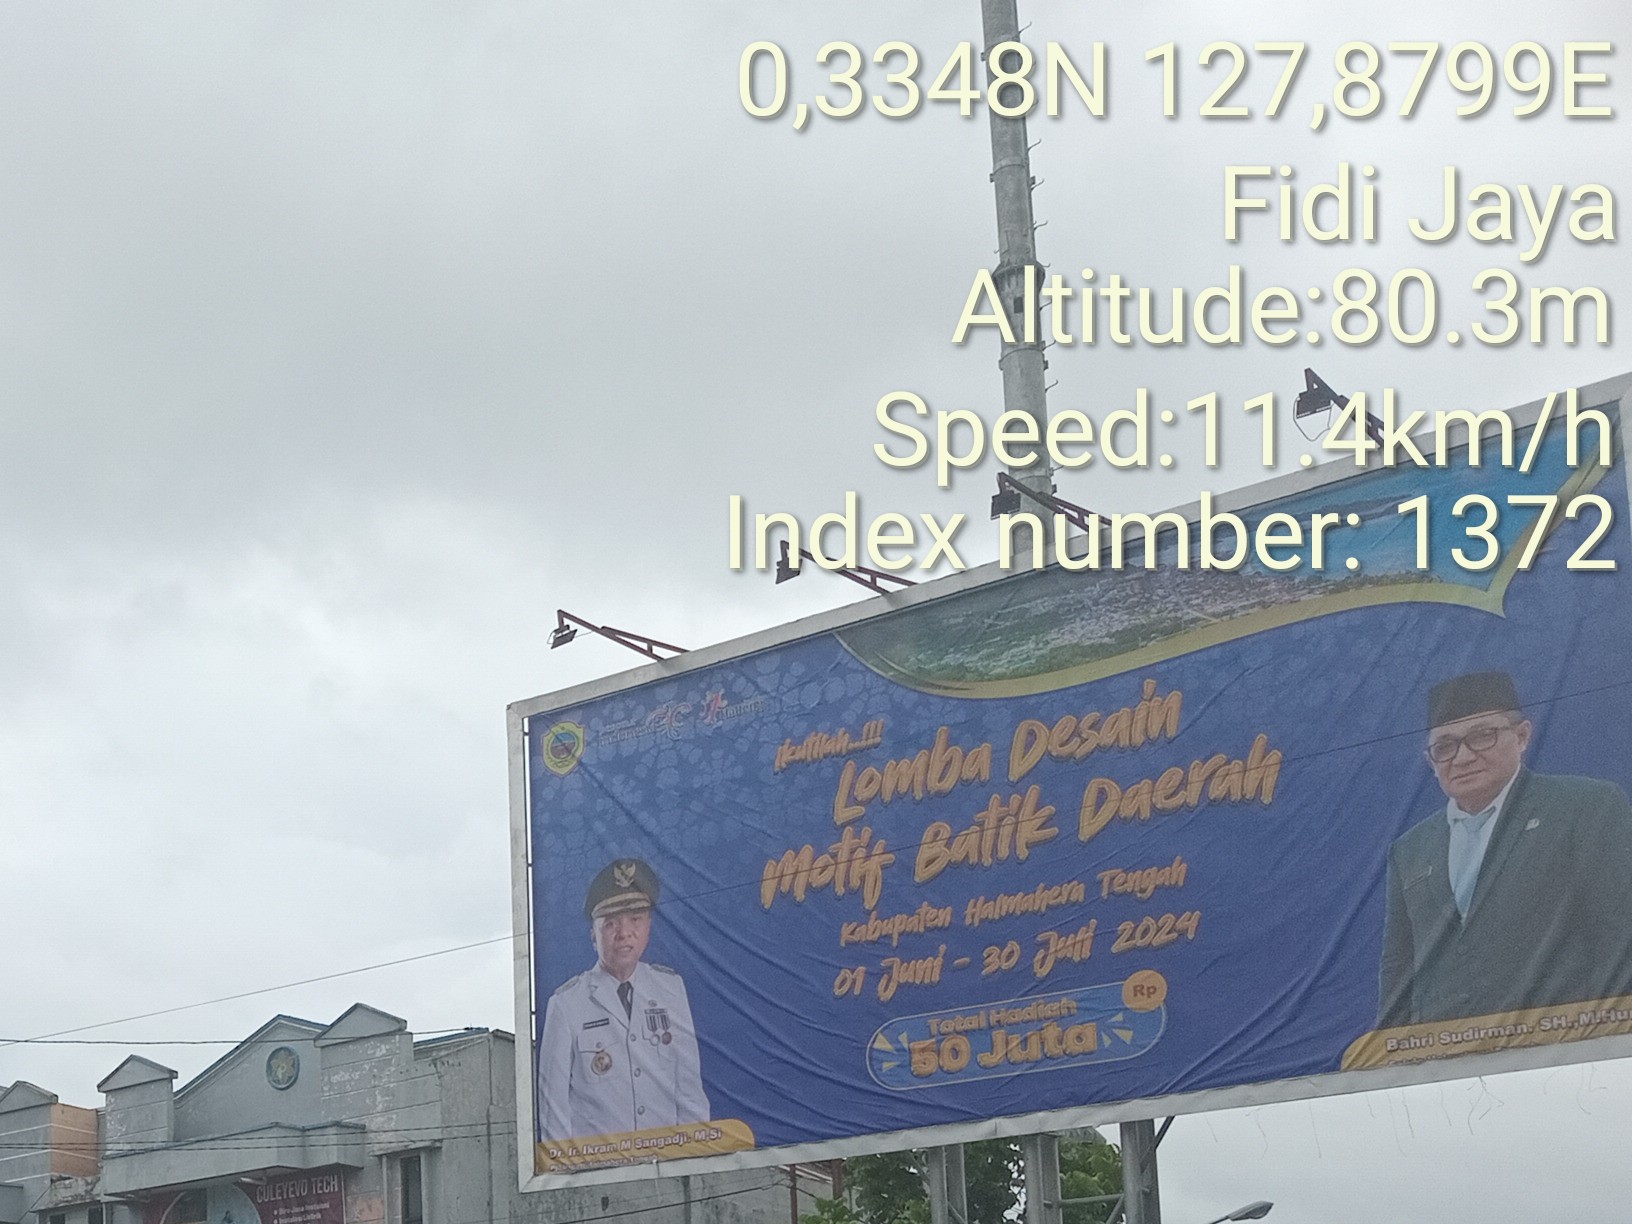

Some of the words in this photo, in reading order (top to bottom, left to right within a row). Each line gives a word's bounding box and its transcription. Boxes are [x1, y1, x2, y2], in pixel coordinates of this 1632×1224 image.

[833, 726, 992, 825] Lomba
[1008, 679, 1183, 782] Desain
[760, 827, 896, 910] Motif
[914, 785, 1060, 882] Batik
[1078, 734, 1283, 842] Daerah
[840, 902, 953, 948] Kabupaten
[964, 882, 1086, 926] Halmahera
[1097, 856, 1188, 899] Tengah
[833, 966, 866, 996] 01
[877, 944, 947, 1002] Juni
[981, 941, 1021, 975] 30
[1034, 918, 1098, 978] Juli
[1111, 911, 1201, 953] 2024
[1132, 984, 1157, 999] Rp
[928, 1010, 986, 1036] Total
[989, 998, 1077, 1027] Hadiah
[909, 1034, 971, 1078] 50
[977, 1021, 1098, 1069] Juta
[1386, 1036, 1434, 1052] Bahri
[549, 1147, 564, 1159] Dr.
[568, 1146, 580, 1157] Ir.
[583, 1143, 617, 1156] Ikram
[620, 1140, 631, 1150] M
[311, 1174, 339, 1196] TECH
